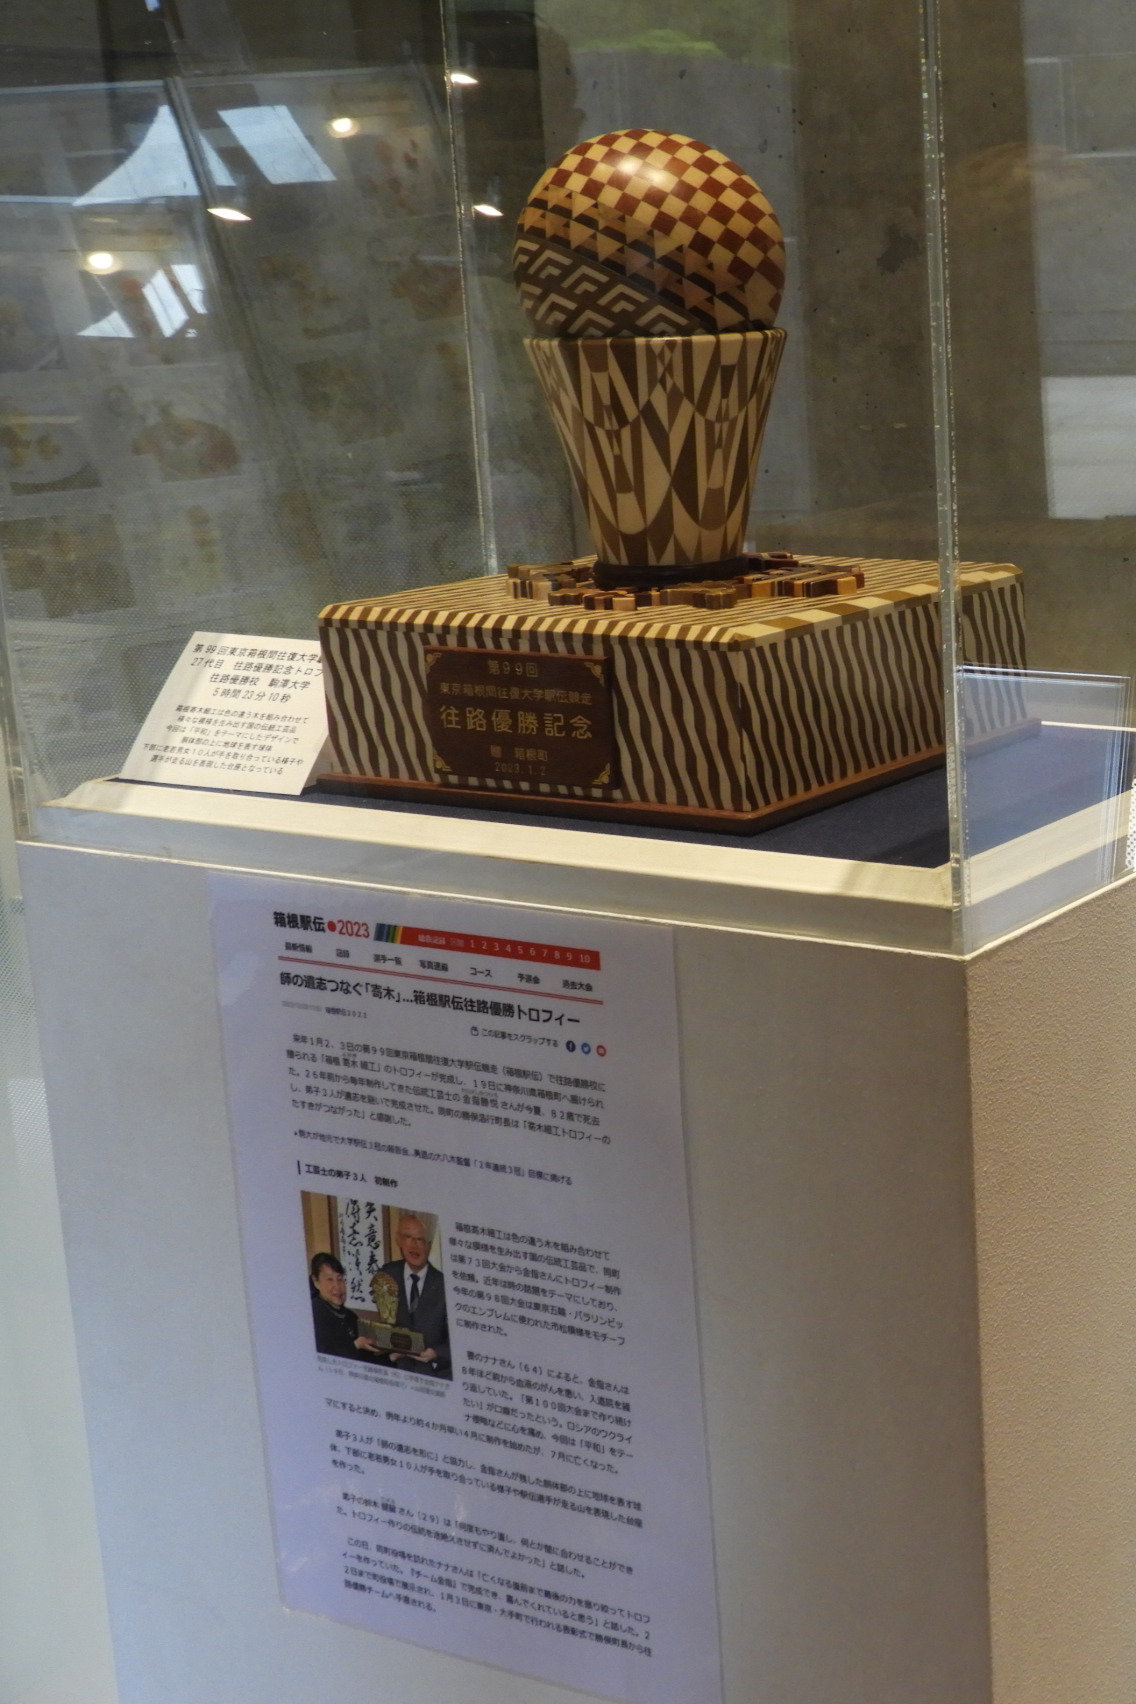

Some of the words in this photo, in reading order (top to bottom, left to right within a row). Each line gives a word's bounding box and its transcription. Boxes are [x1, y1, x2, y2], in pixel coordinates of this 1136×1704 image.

[210, 673, 260, 686] 往路優勝校
[440, 705, 592, 740] 往路優勝記念
[272, 911, 326, 933] 箱根駅伝
[336, 919, 370, 939] 2023
[469, 967, 492, 978] コース
